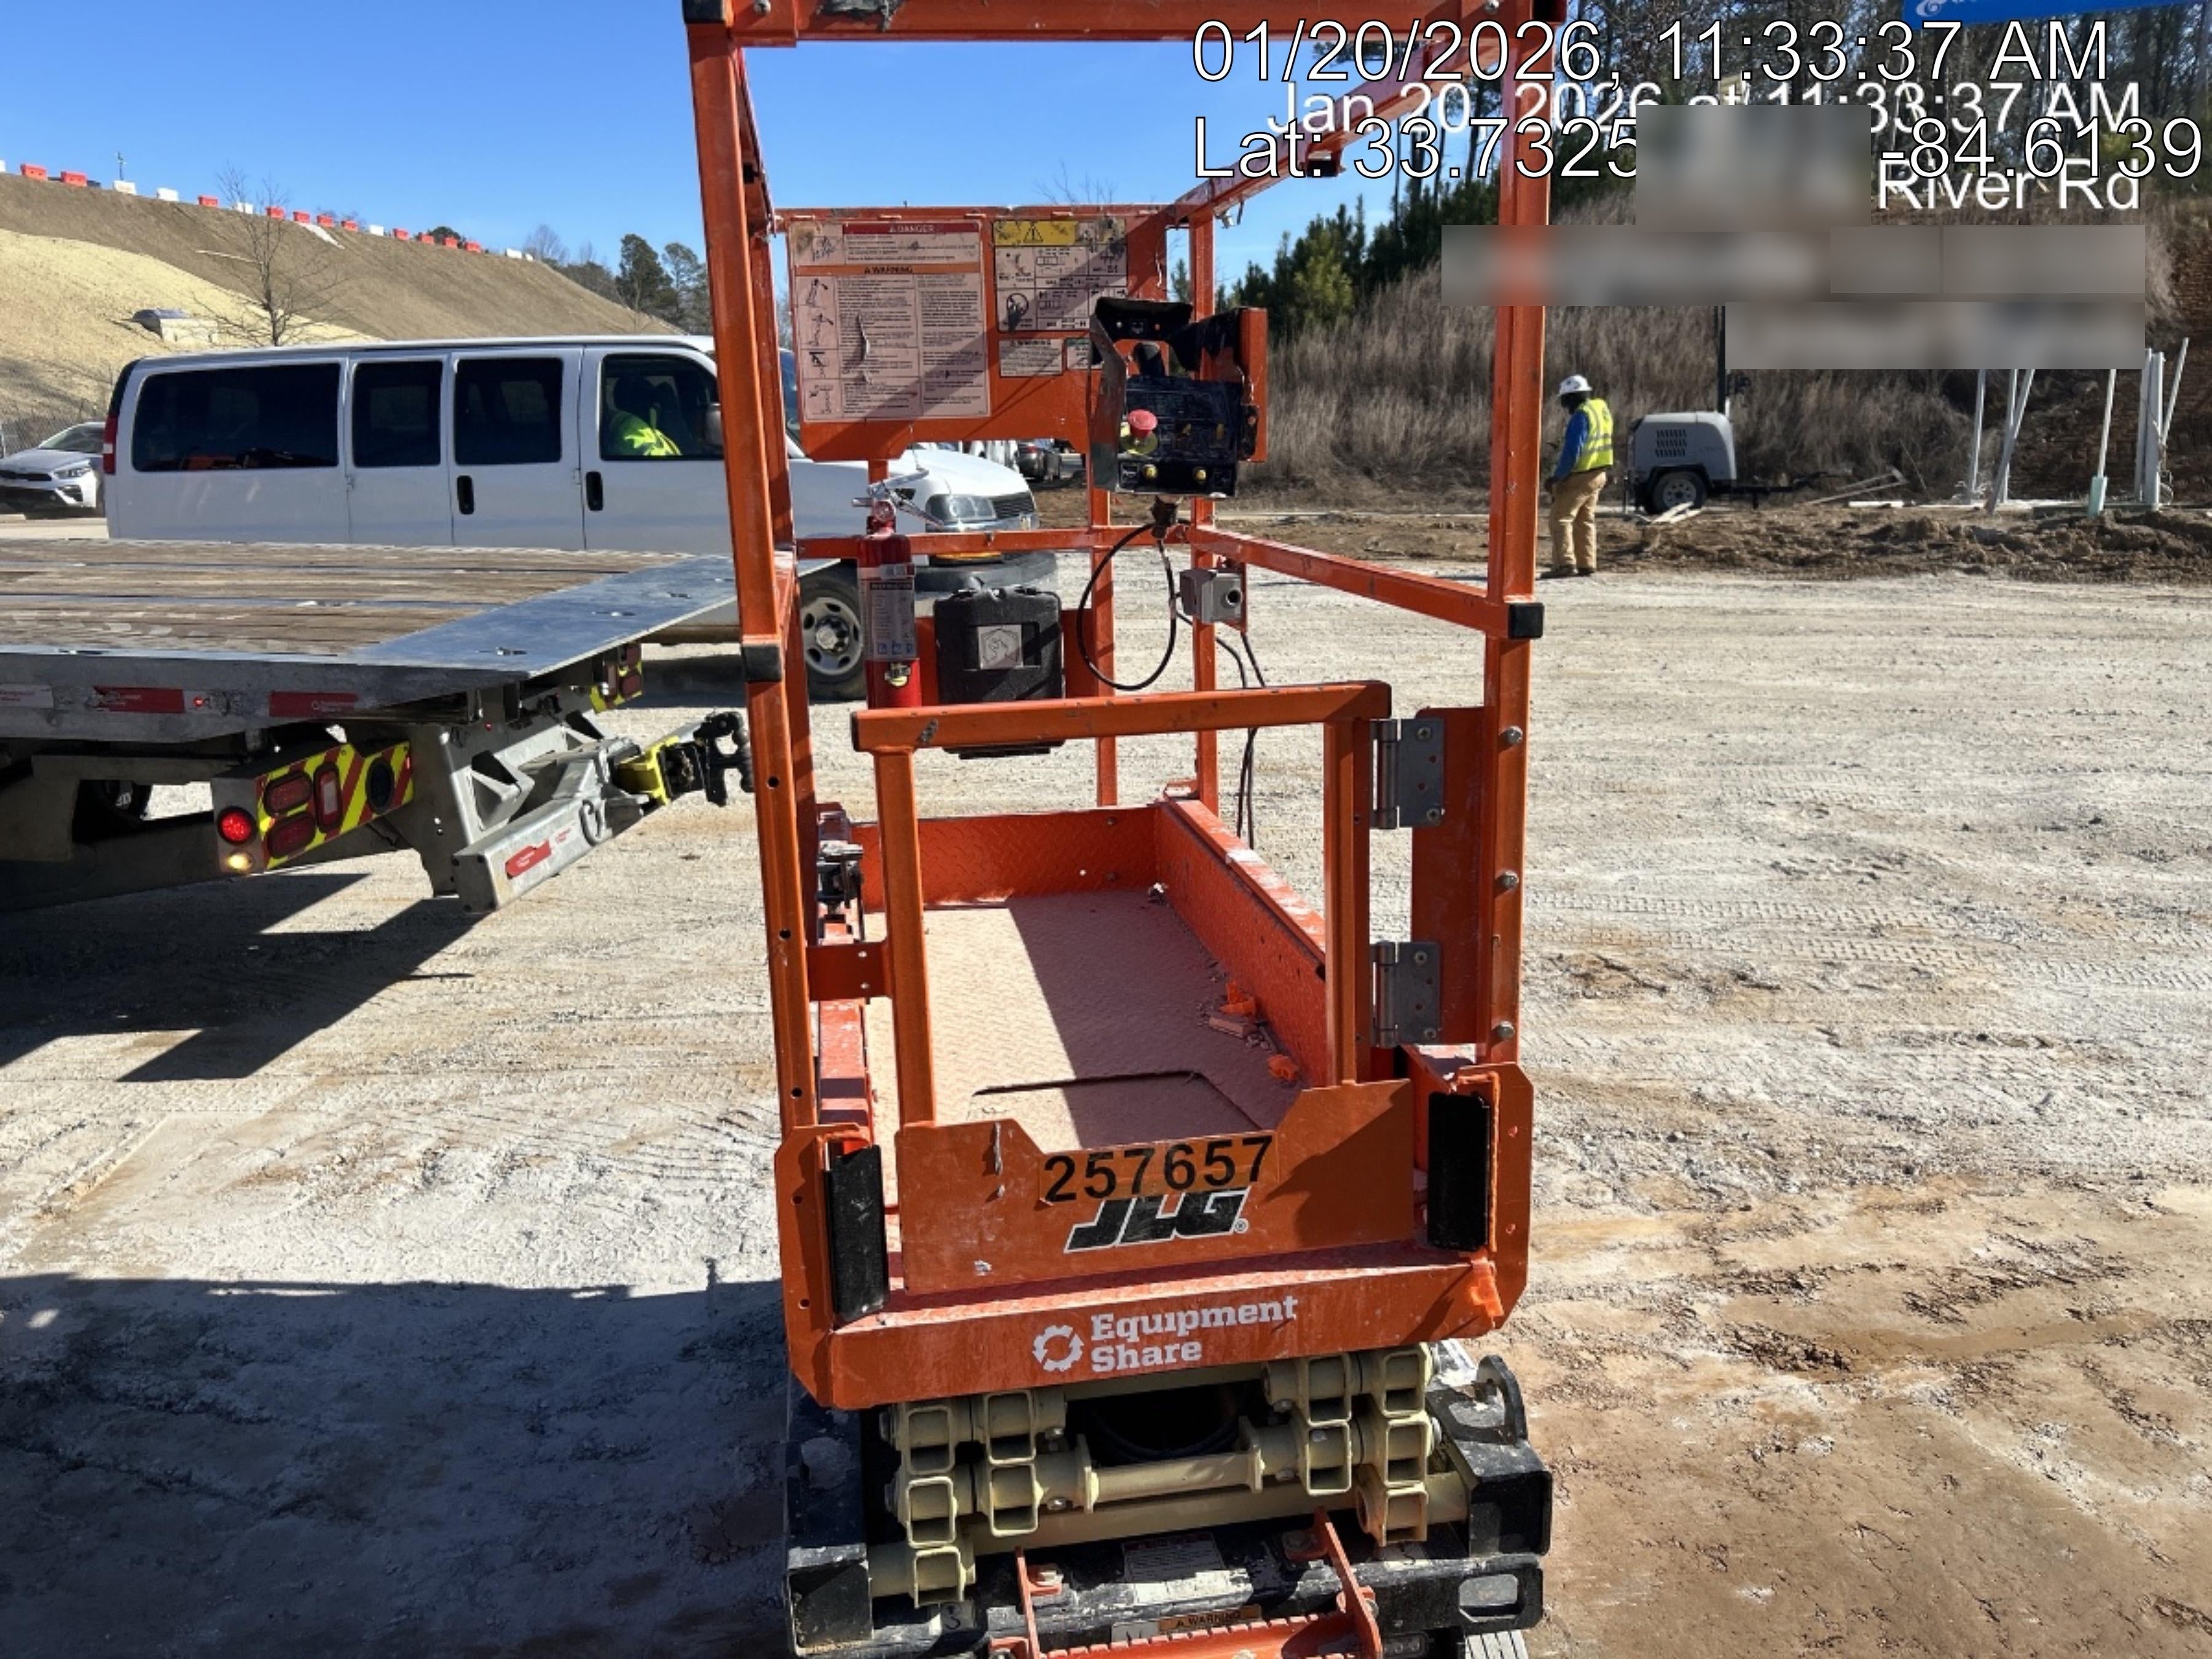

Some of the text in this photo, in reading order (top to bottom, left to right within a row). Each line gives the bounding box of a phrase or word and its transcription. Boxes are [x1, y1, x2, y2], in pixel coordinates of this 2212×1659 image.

[1045, 1135, 1273, 1202] 257657
[1091, 1295, 1298, 1343] Equipment
[1091, 1341, 1202, 1373] Share
[1188, 1609, 1241, 1626] WARNING
